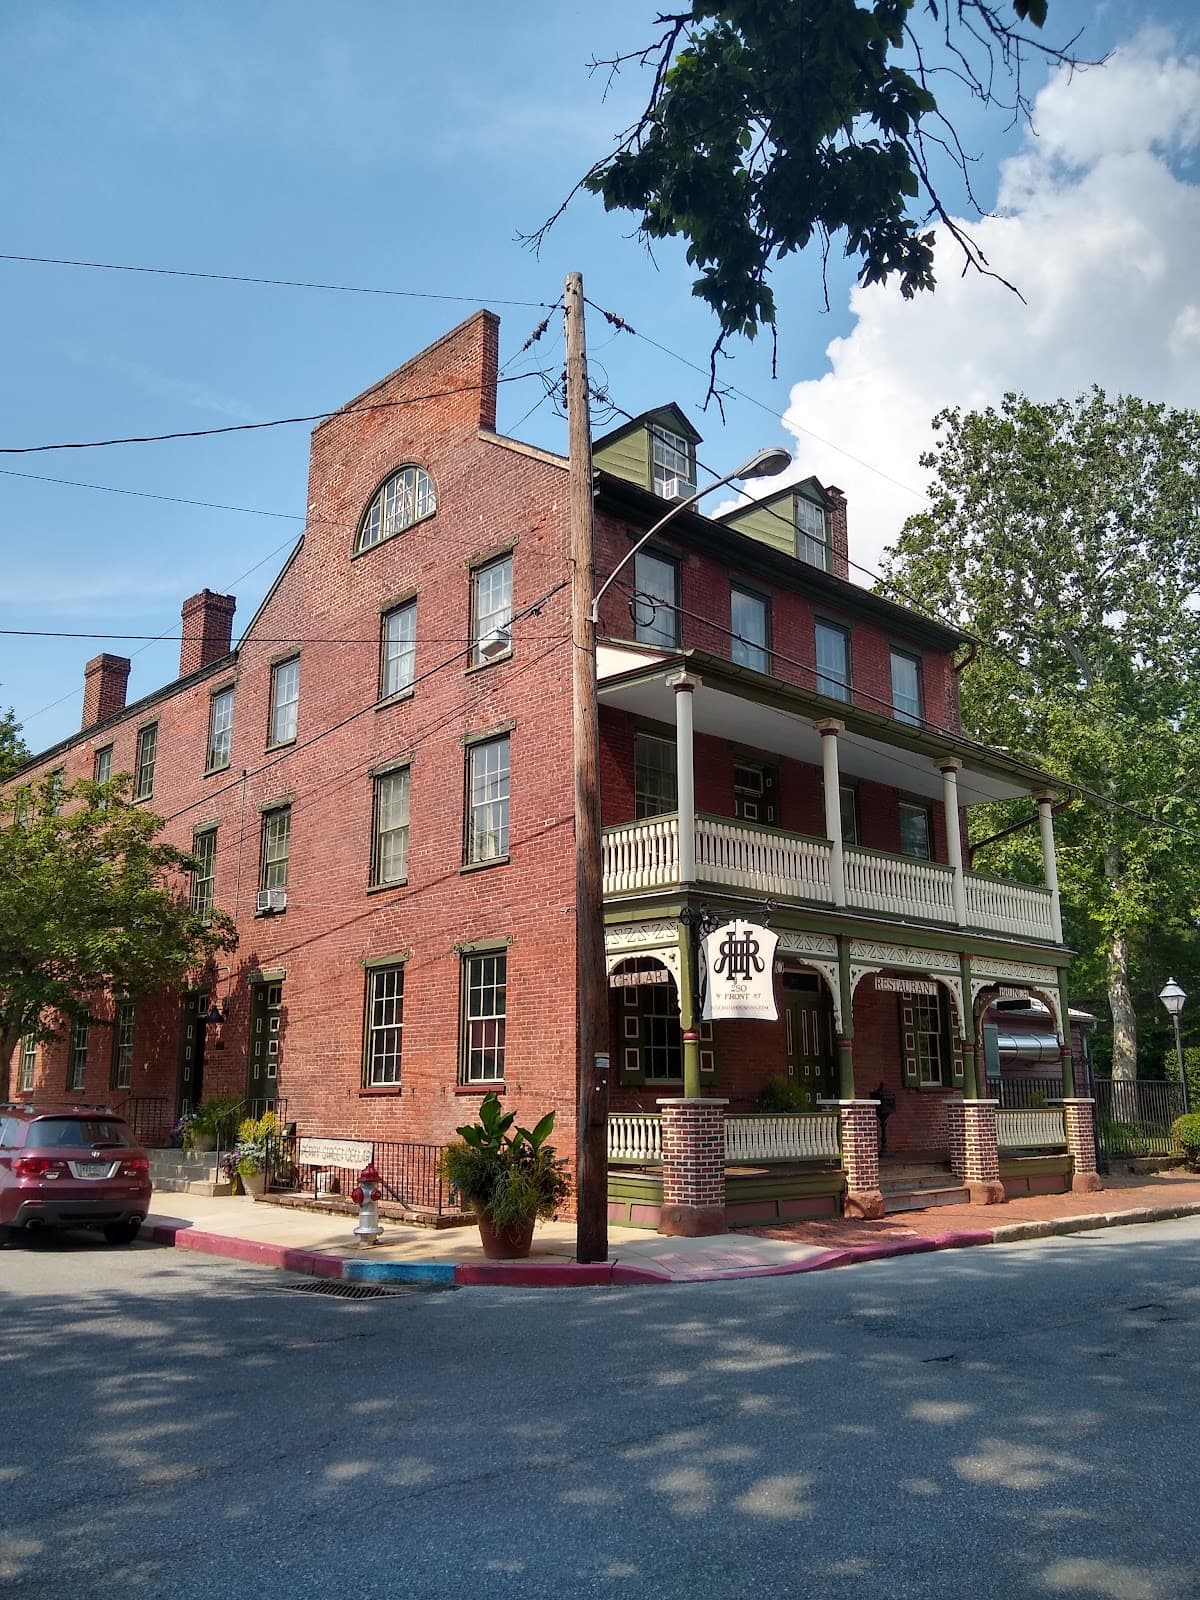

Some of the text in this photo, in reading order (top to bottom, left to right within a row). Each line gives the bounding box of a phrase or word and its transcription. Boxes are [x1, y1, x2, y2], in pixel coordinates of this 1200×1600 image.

[614, 970, 662, 986] CELLAR
[876, 977, 936, 994] RESTAURANT
[998, 986, 1029, 1000] BRUNCH
